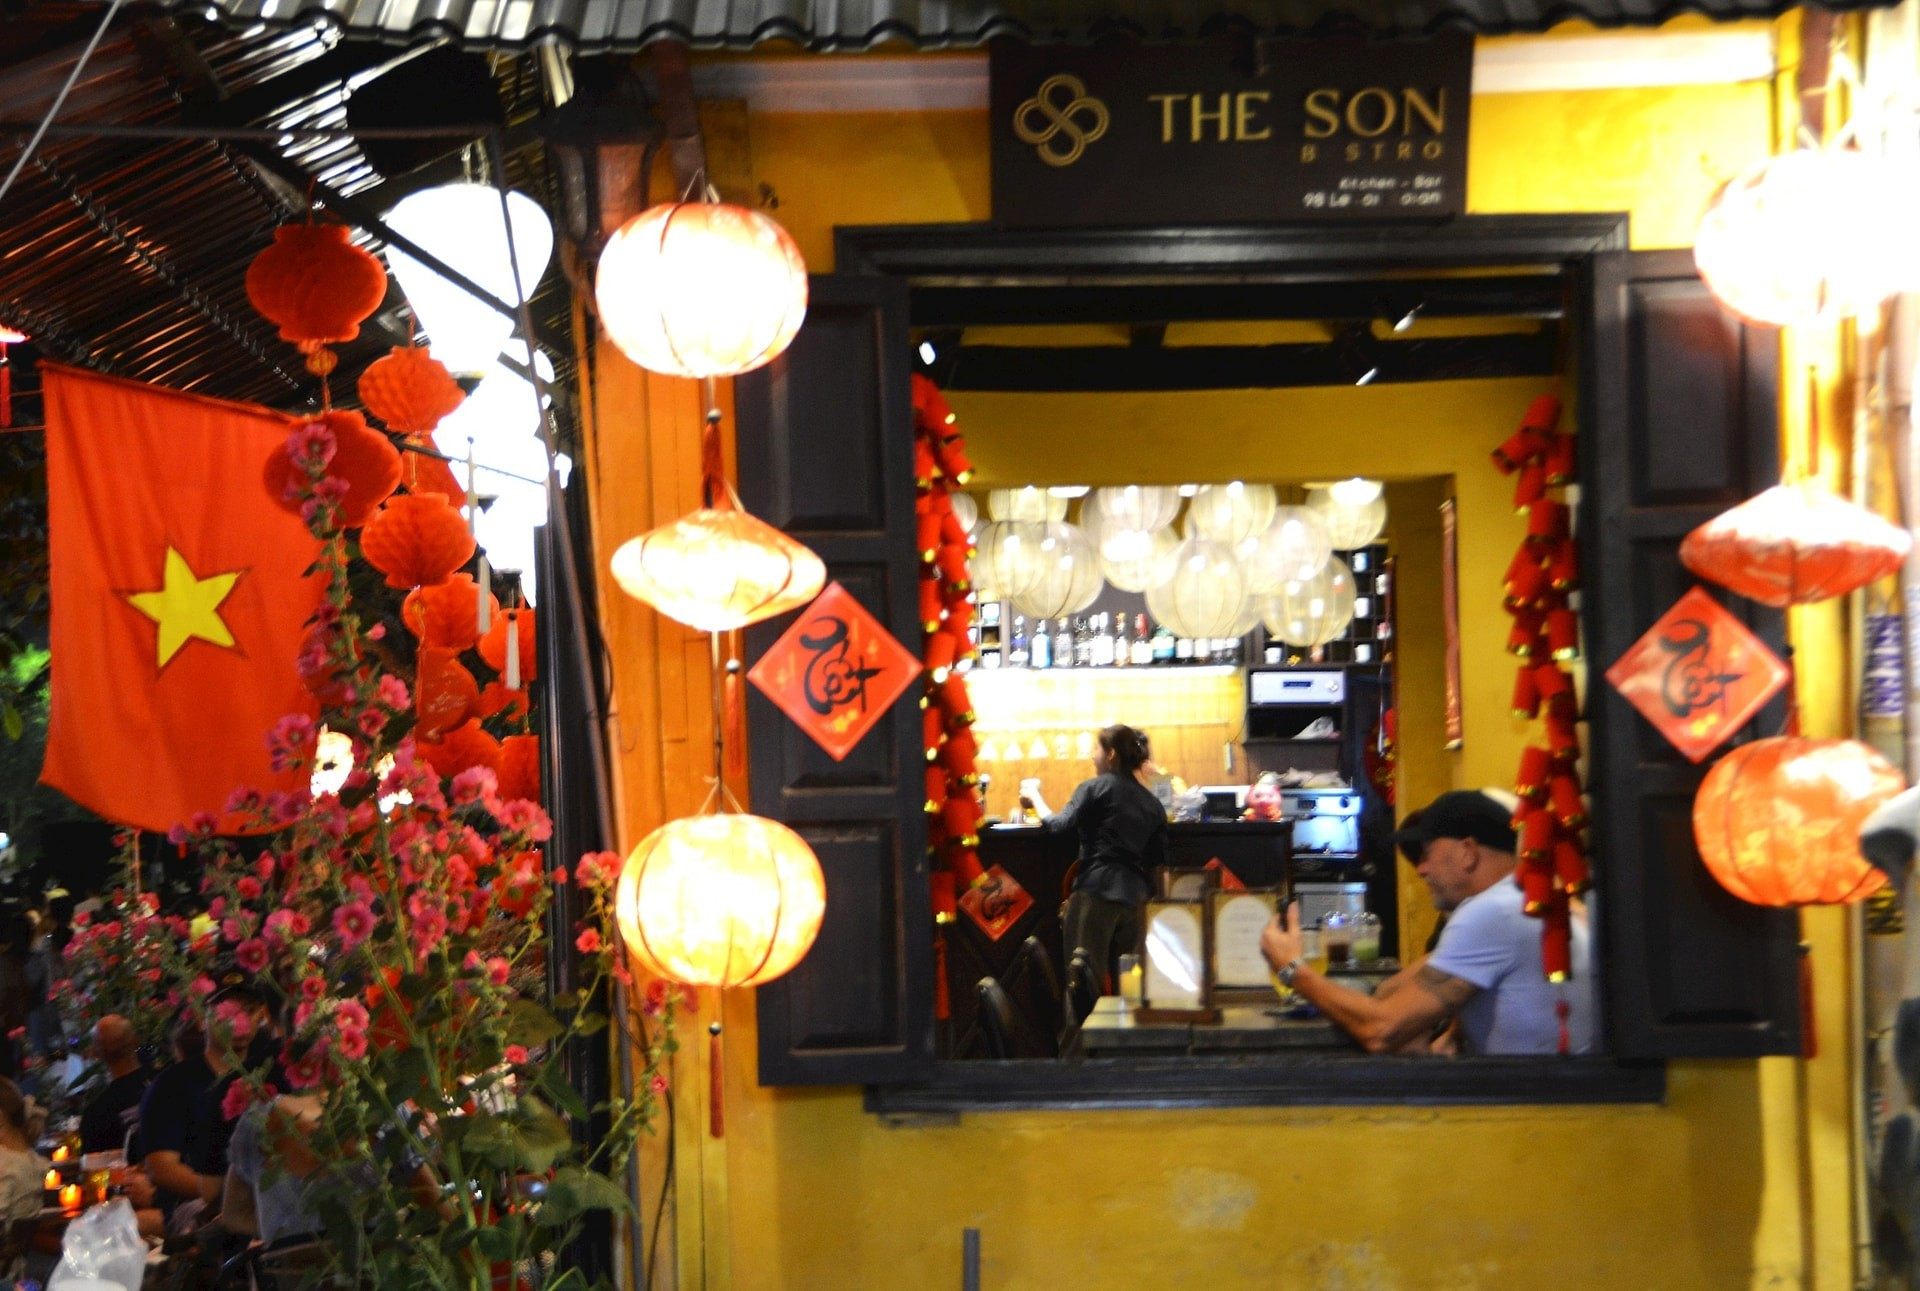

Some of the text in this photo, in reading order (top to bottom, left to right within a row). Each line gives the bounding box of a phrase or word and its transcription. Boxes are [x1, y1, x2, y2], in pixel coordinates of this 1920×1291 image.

[1148, 86, 1446, 142] THE SON
[1301, 140, 1443, 163] BSTRO
